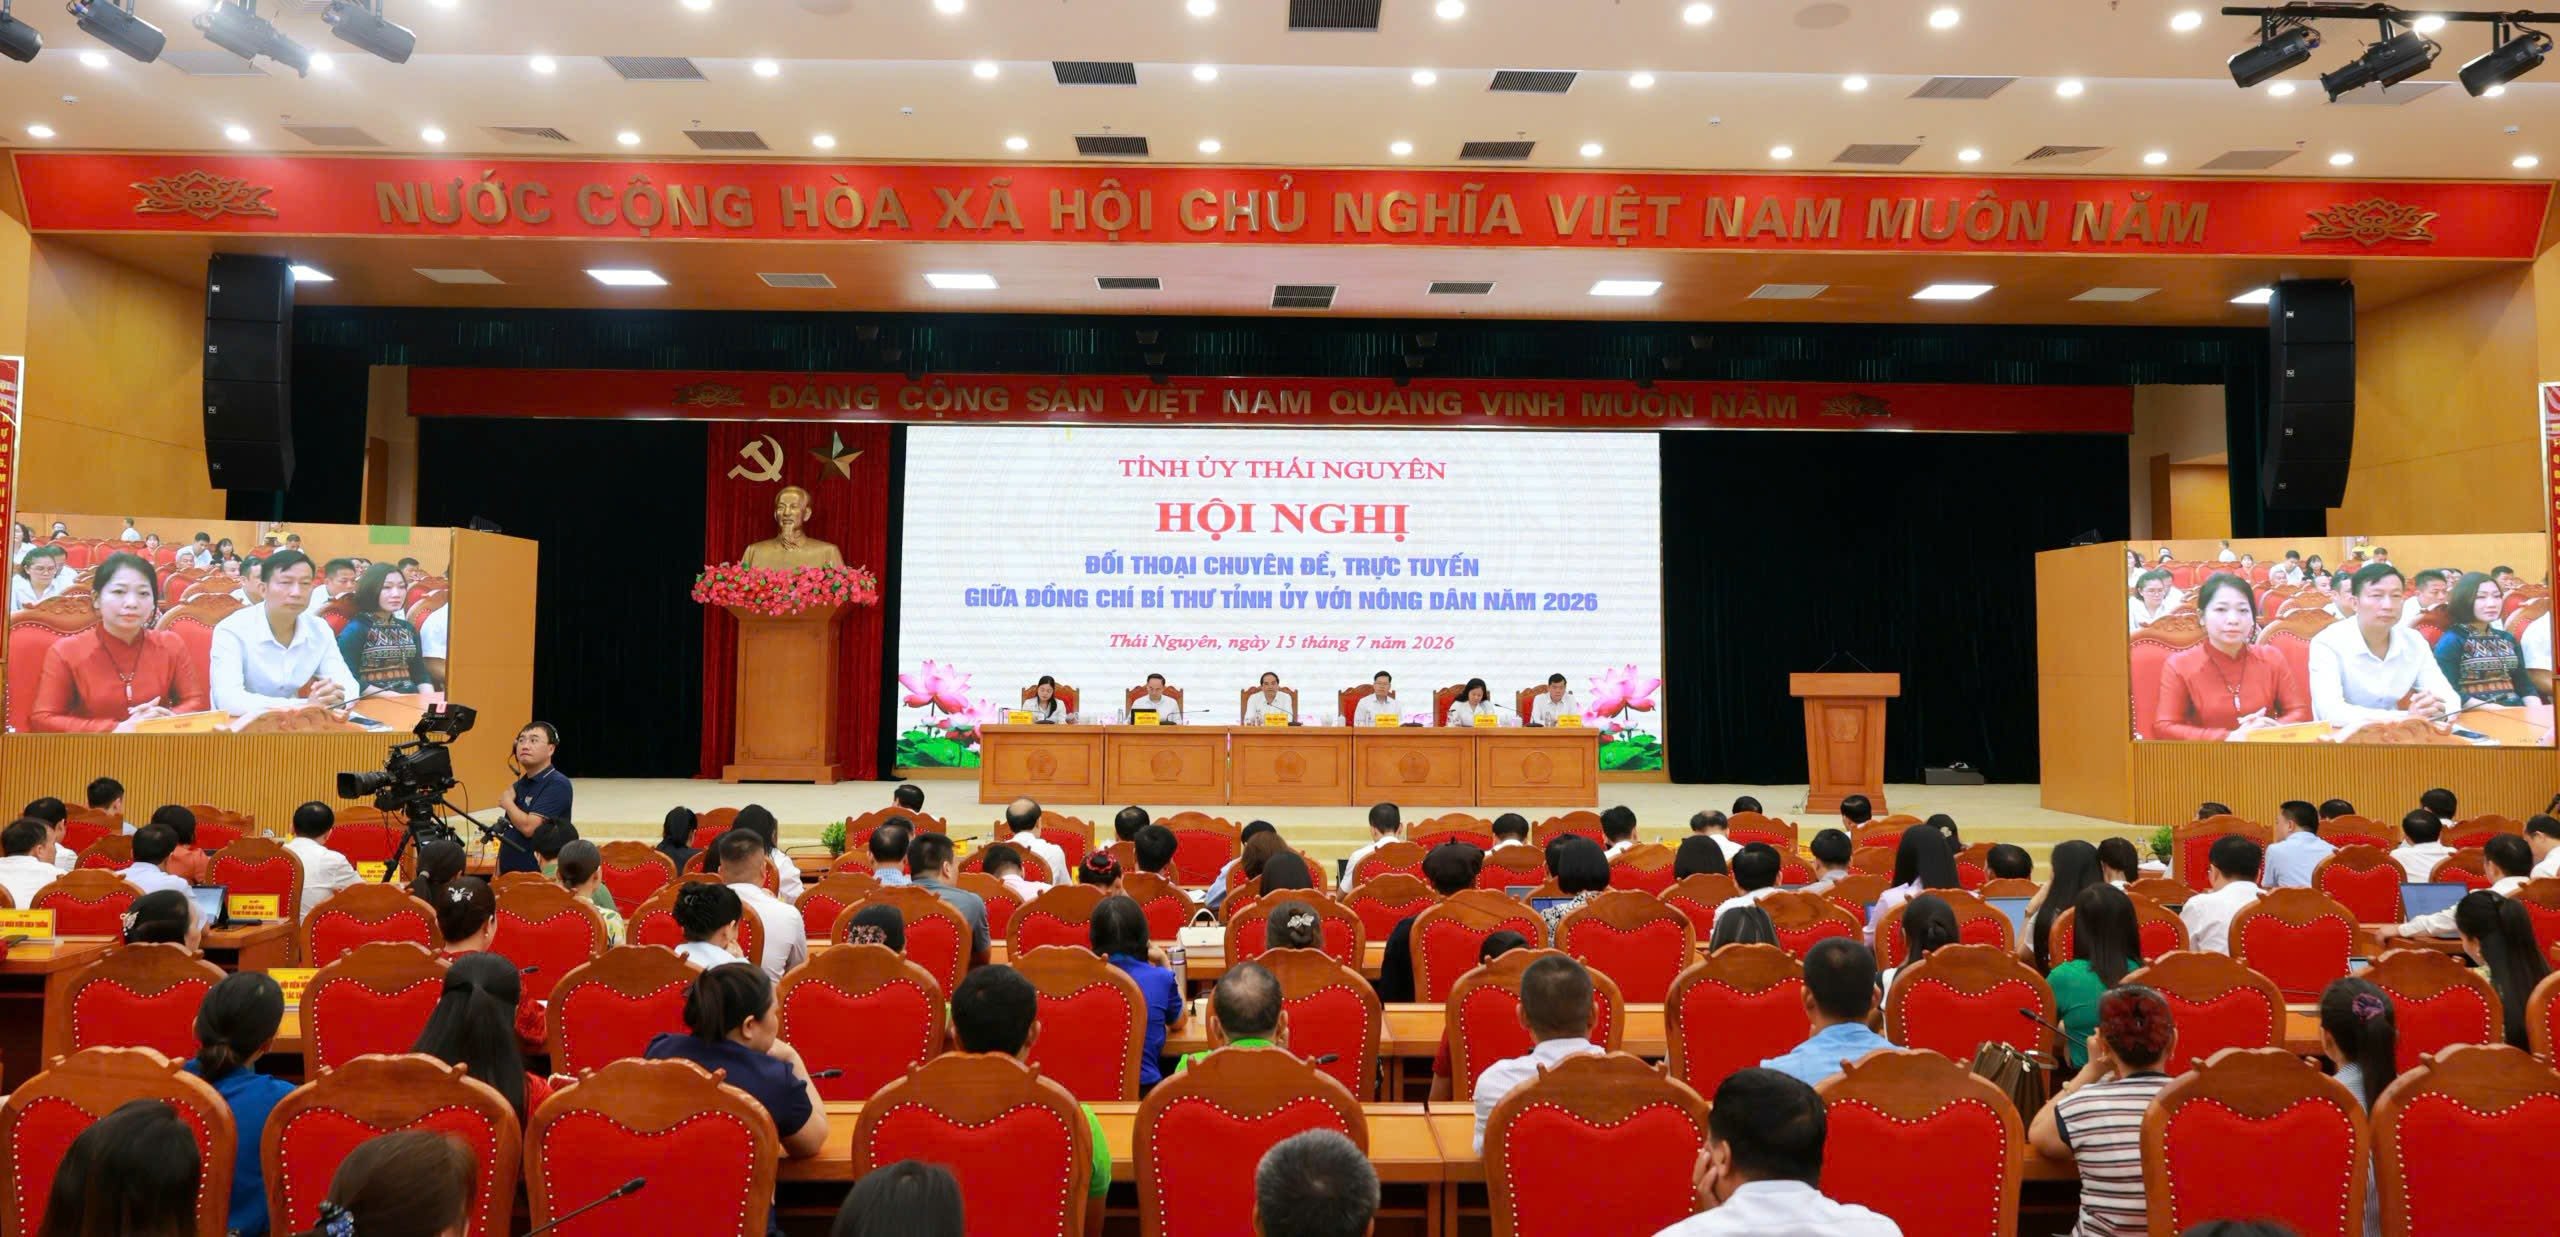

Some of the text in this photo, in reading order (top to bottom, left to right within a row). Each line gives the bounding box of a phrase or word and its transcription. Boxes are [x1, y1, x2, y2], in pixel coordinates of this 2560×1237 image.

[375, 168, 2209, 246] NƯỚC CỘNG HÒA XÃ HỘI CHỦ NGHĨA VIỆT NAM MUÔN NĂM
[768, 376, 879, 410] ĐẢNG
[898, 379, 1009, 418] CỘNG
[1026, 379, 1104, 413] SẢN
[1222, 389, 1311, 415] NAM
[1329, 390, 1462, 416] QUANG
[1478, 391, 1566, 418] VINH
[1711, 385, 1798, 420] NĂM
[1118, 455, 1446, 480] TỈNH ỦY THÁI NGUYÊN
[1155, 497, 1410, 543] HỘI NGHỊ
[1085, 550, 1480, 580] ĐỐI THOẠI CHUYÊN ĐỀ, TRỰC TUYẾN
[964, 582, 1599, 612] GIỮA ĐỒNG CHÍ BÍ THƯ TỈNH ỦY VỚI NÔNG DÂN NĂM 2026
[1110, 634, 1455, 652] Thái Nguyên, ngày 15 tháng 7 năm 2026
